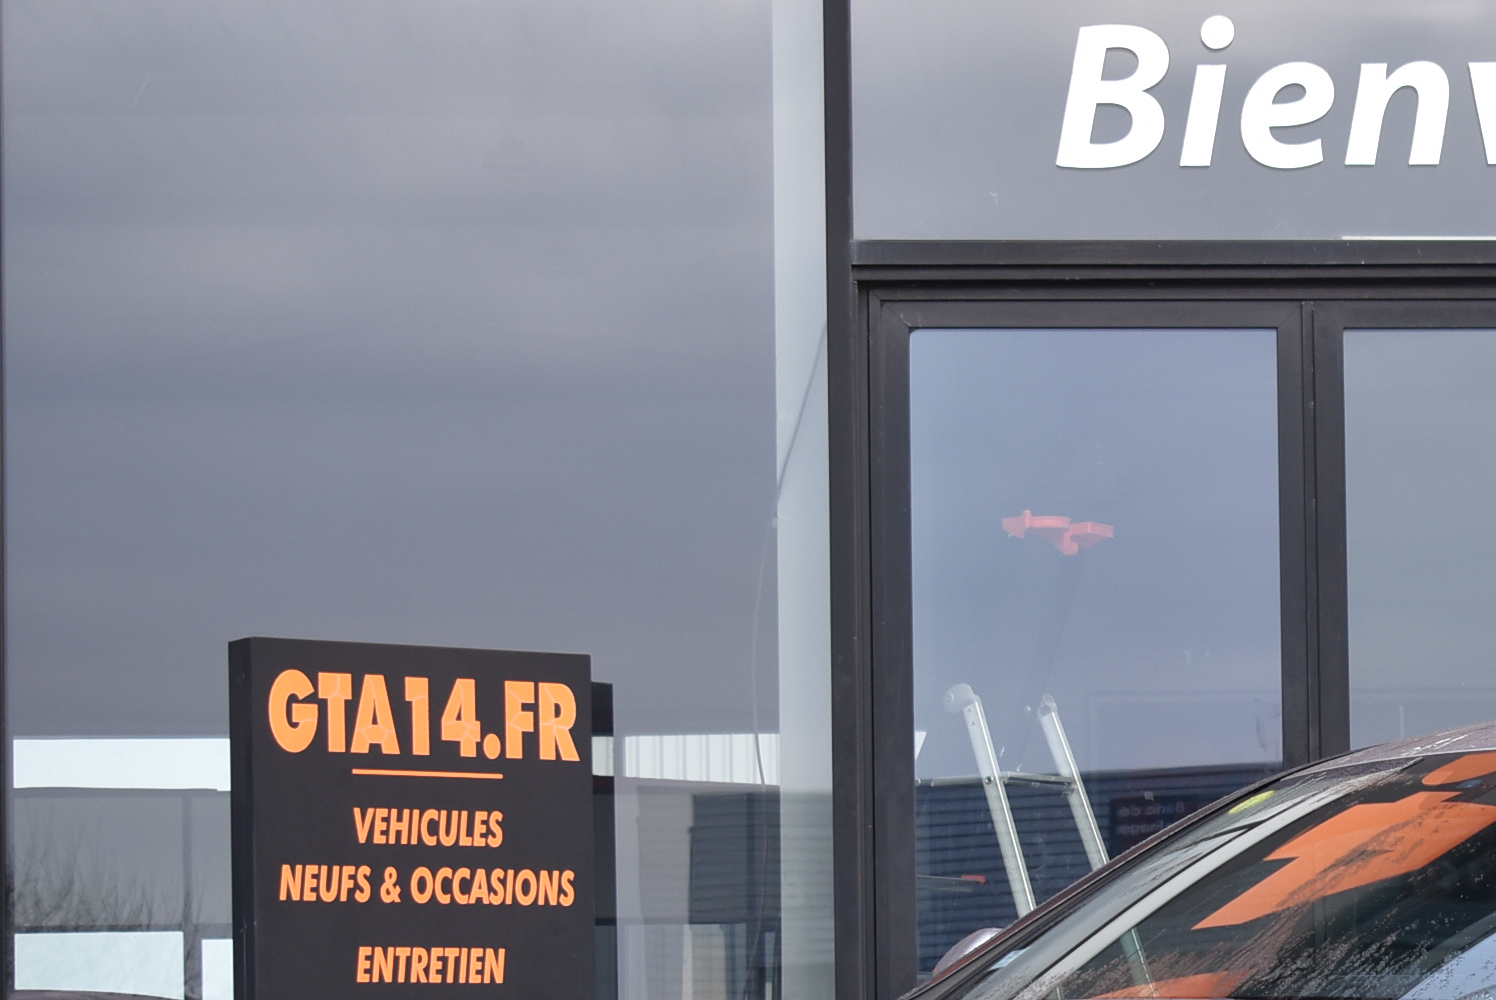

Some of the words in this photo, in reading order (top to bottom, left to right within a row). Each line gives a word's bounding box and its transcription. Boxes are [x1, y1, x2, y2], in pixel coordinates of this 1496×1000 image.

[268, 668, 580, 762] GTA14.FR
[353, 807, 504, 848] VEHICULES
[279, 864, 372, 903] NEUFS
[379, 866, 402, 904] &
[410, 866, 575, 907] OCCASIONS
[356, 946, 506, 984] ENTRETIEN
